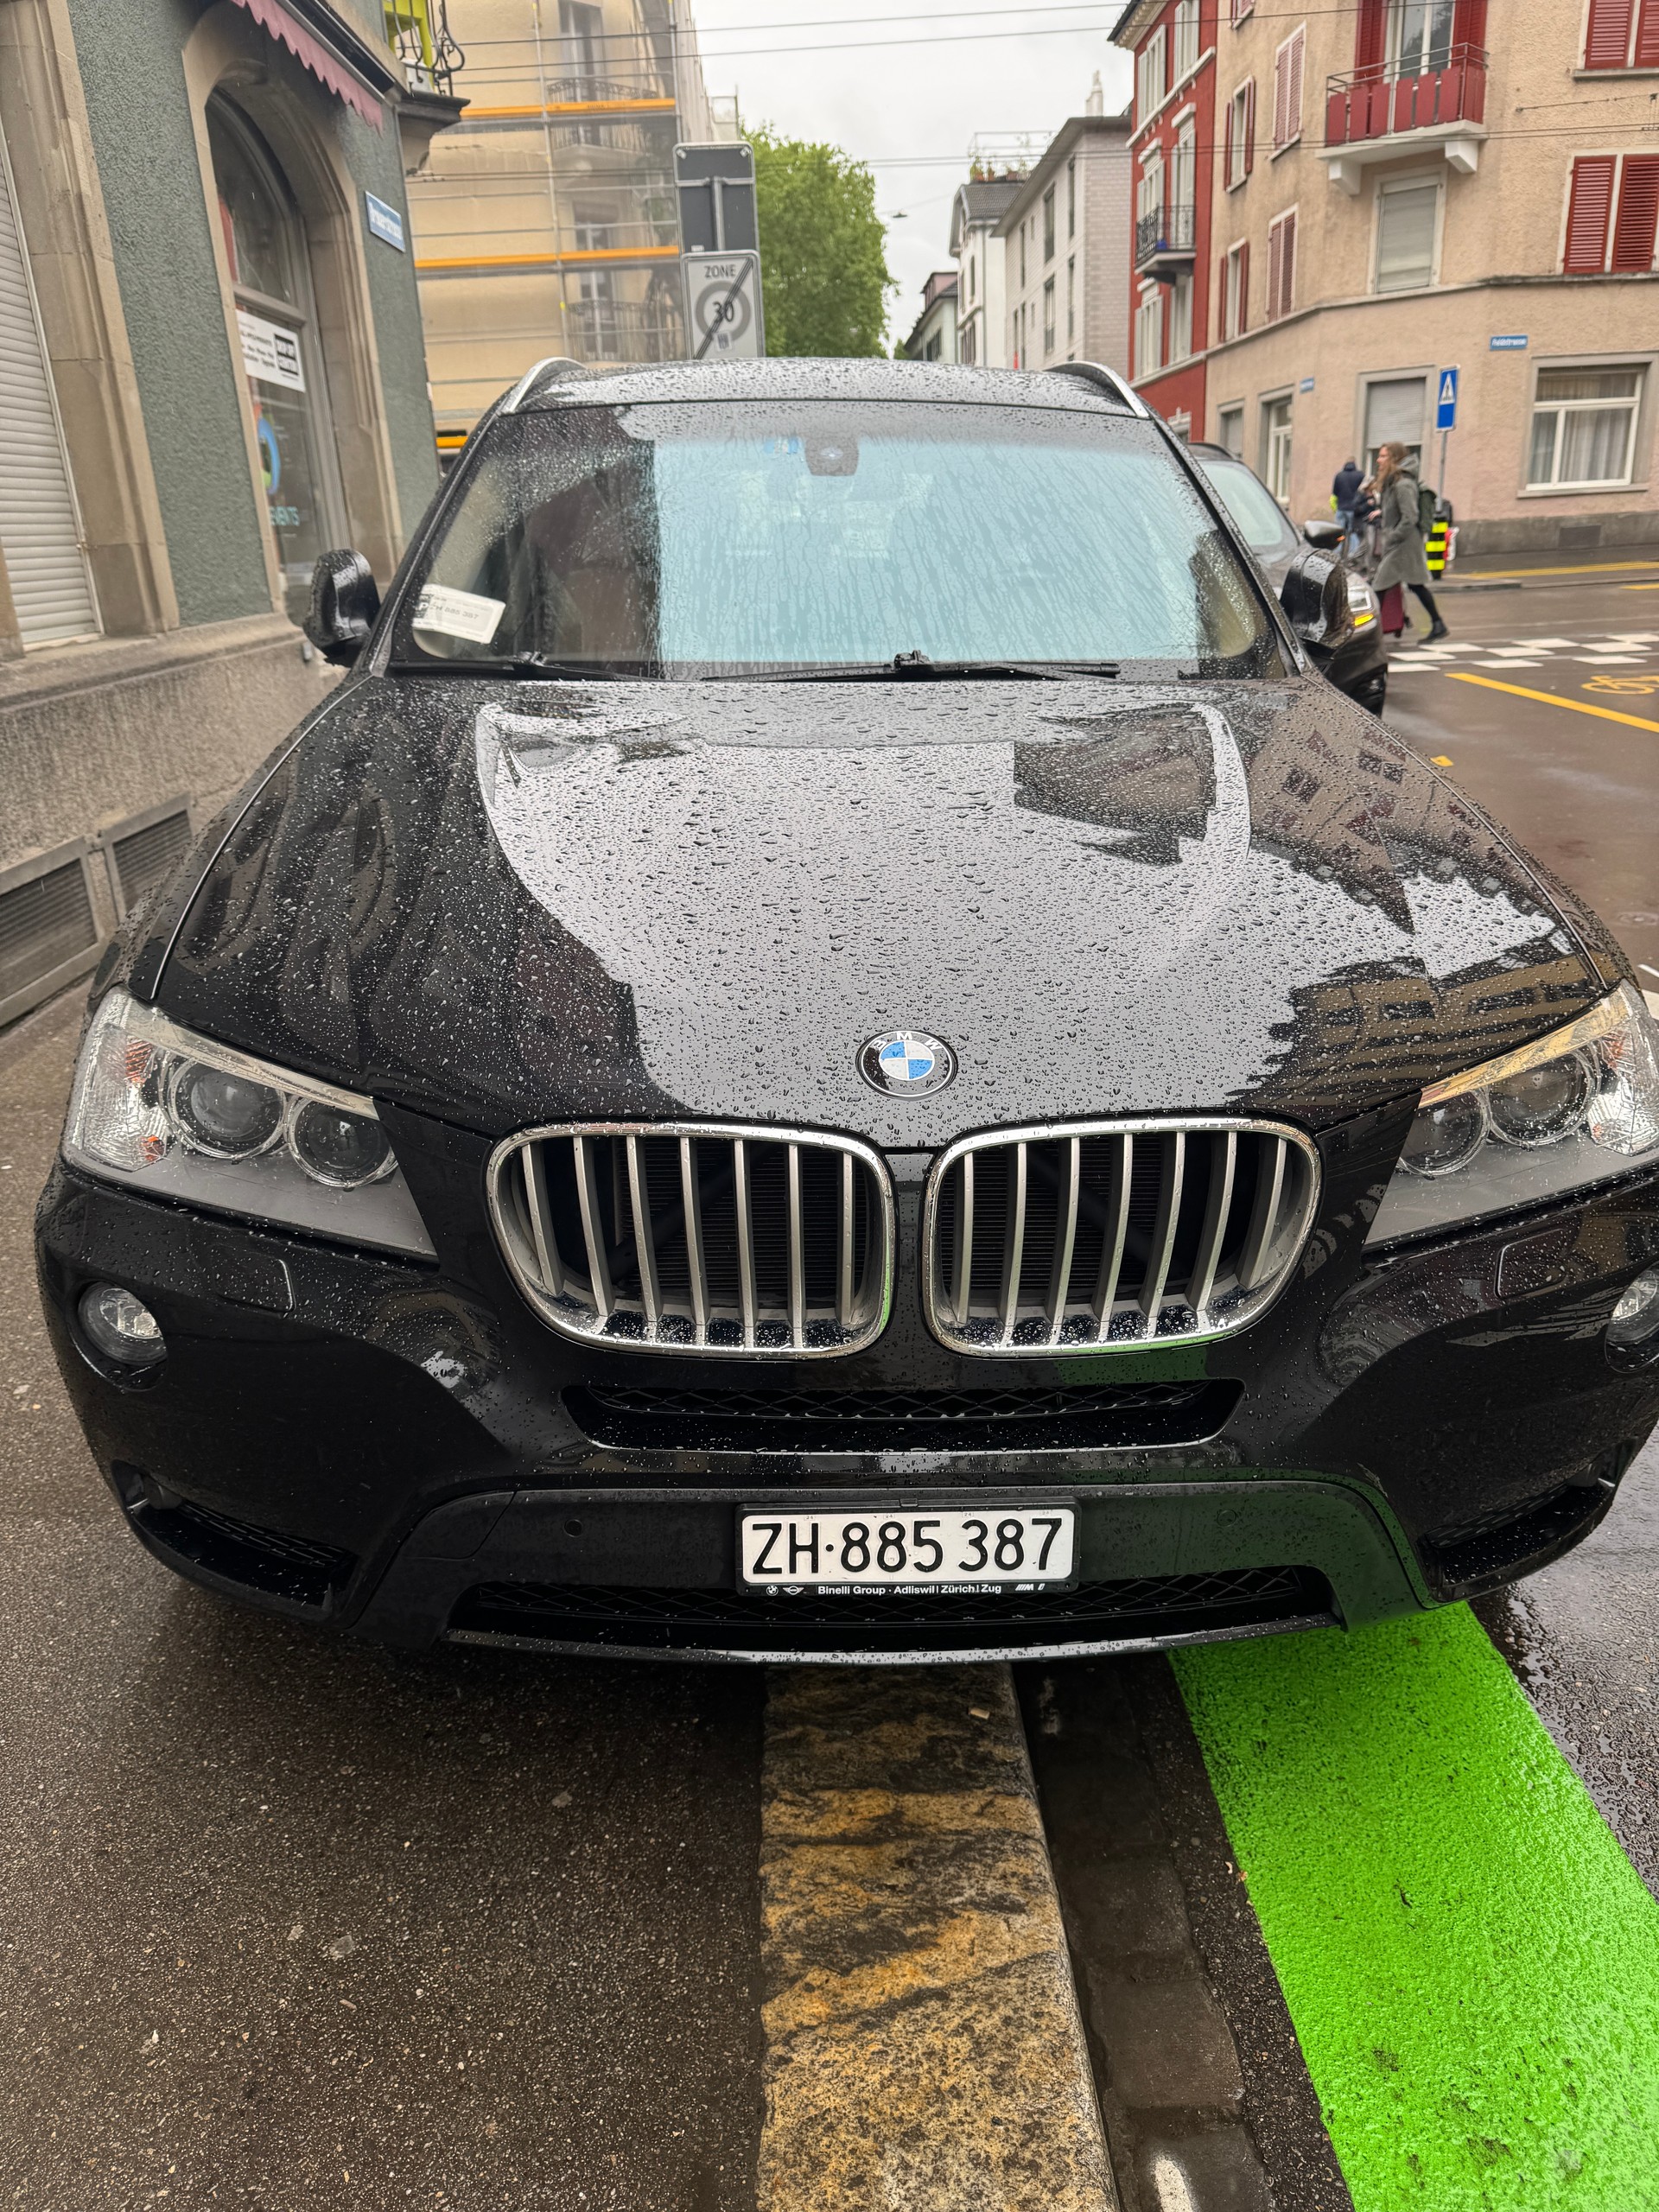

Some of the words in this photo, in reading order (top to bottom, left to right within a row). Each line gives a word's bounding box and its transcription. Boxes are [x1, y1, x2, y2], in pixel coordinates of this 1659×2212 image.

[704, 264, 736, 278] ZONE
[713, 302, 734, 322] 30
[871, 1032, 943, 1052] BMW
[818, 1586, 849, 1595] Binelli
[853, 1586, 886, 1596] Group
[894, 1586, 935, 1594] Adliswil
[941, 1584, 975, 1593] Zürich
[982, 1584, 1001, 1594] Zug
